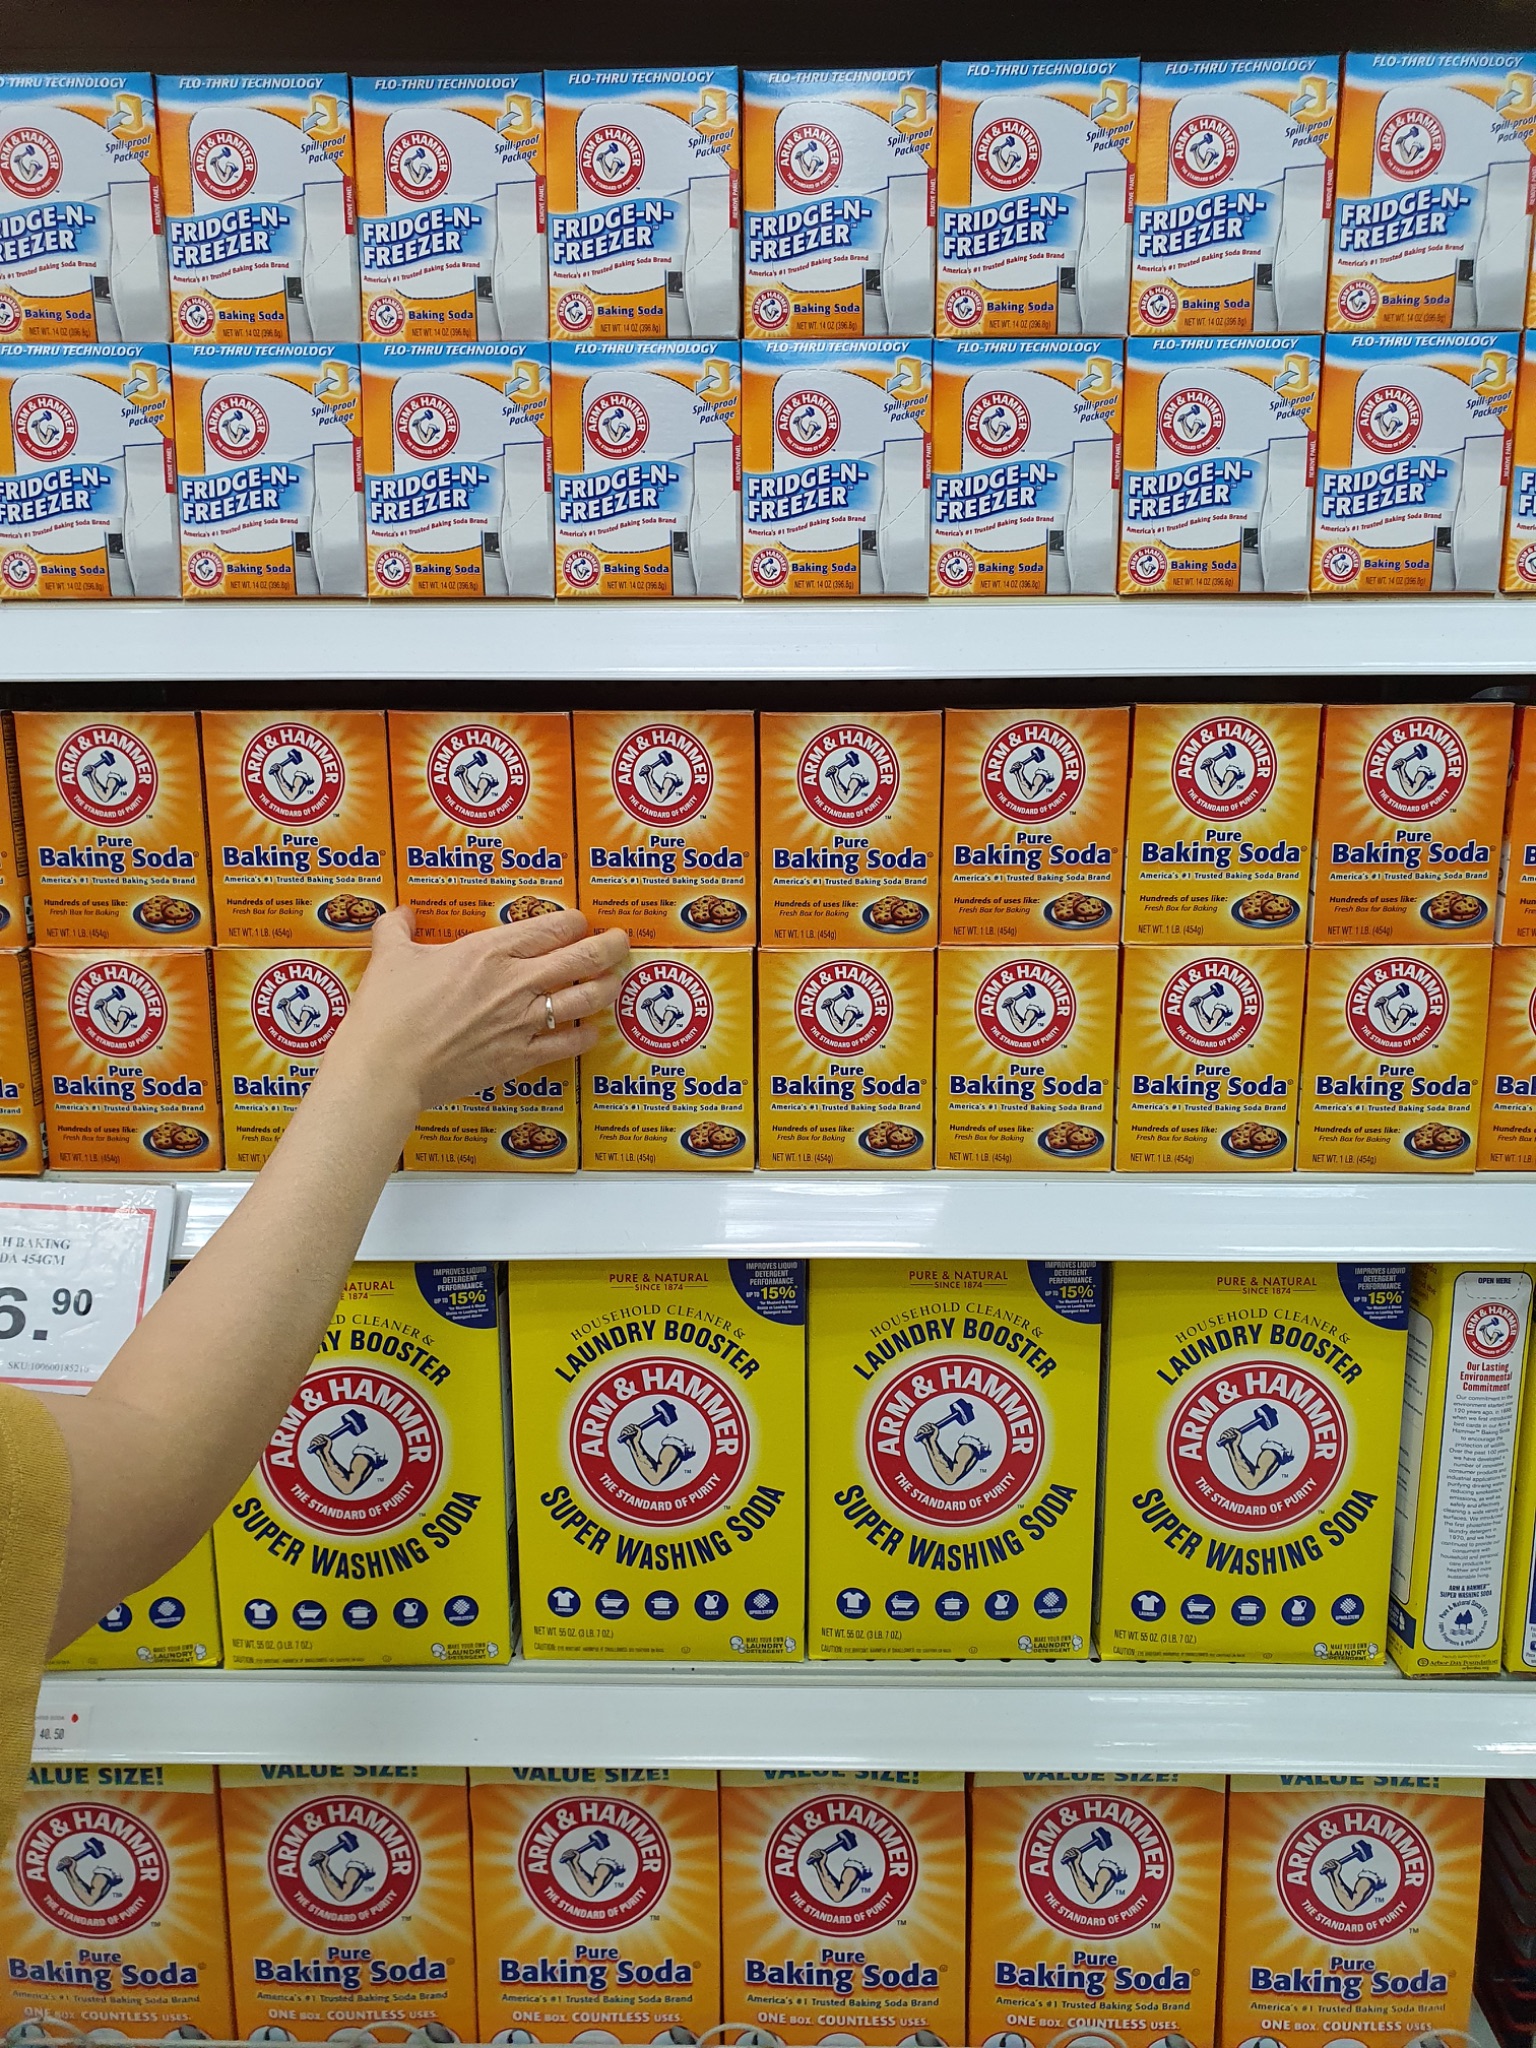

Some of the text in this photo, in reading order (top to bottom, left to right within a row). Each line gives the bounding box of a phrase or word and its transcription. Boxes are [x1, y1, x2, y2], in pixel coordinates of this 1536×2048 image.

[568, 71, 714, 85] FLO-THRU TECHNOLOGY
[688, 128, 734, 148] Spill-proof
[583, 129, 640, 168] ARM & HAMMER
[695, 143, 731, 158] Package
[1341, 186, 1471, 228] FRIDGE-N-
[170, 206, 289, 244] FRIDGE-N-
[552, 201, 674, 240] FRIDGE-N-
[1338, 212, 1447, 251] FREEZER
[553, 226, 654, 264] FREEZER
[553, 271, 581, 279] America's
[592, 265, 613, 276] Trusted
[614, 260, 635, 269] Baking
[597, 306, 663, 317] Baking Soda
[601, 324, 611, 332] NET
[624, 324, 630, 332] 14
[1351, 335, 1498, 347] FLO-THRU TECHNOLOGY
[1323, 459, 1448, 494] FRIDGE-N-
[1322, 483, 1425, 517] FREEZER
[1364, 559, 1430, 570] Baking Soda
[804, 730, 894, 786] ARM & HAMMER
[813, 795, 884, 819] THE STANDARD OF PURITY
[97, 835, 133, 847] Pure
[834, 836, 869, 848] Pure
[1396, 830, 1432, 843] Pure
[39, 846, 194, 873] Baking Soda
[773, 847, 927, 874] Baking Soda
[1332, 841, 1489, 869] Baking Soda
[855, 878, 881, 886] Baking
[905, 877, 927, 885] Brand
[825, 910, 849, 918] Baking
[774, 929, 787, 938] NET
[788, 929, 798, 938] WT.
[806, 930, 815, 938] LB.
[817, 929, 837, 940] (454g)
[1352, 964, 1442, 1016] ARM & HAMMER
[1379, 1064, 1415, 1076] Pure
[1316, 1075, 1471, 1101] Baking Soda
[16, 1238, 71, 1249] BAKING
[22, 1254, 65, 1265] 454GM
[609, 1272, 708, 1283] PURE & NATURAL
[750, 1278, 794, 1286] PERFORMANCE
[754, 1270, 788, 1278] DETERGENT
[635, 1283, 660, 1291] SINCE
[52, 1288, 93, 1316] 90
[570, 1304, 661, 1341] HOUSEHOLD
[666, 1304, 734, 1332] CLEANER
[734, 1327, 746, 1339] &
[555, 1320, 760, 1383] LAUNDRY BOOSTER
[1460, 1371, 1512, 1381] Environmental
[1467, 1362, 1509, 1372] Our Lasting
[1463, 1382, 1510, 1392] Commitment
[581, 1367, 738, 1458] ARM & HAMMER
[599, 1473, 722, 1512] THE STANDARD OF PURITY
[540, 1484, 786, 1571] SUPER WASHING SODA
[1114, 1630, 1126, 1640] NET
[1127, 1630, 1138, 1640] WT.
[1140, 1631, 1148, 1642] 55
[1160, 1632, 1168, 1643] (3
[1169, 1632, 1178, 1643] LB.
[27, 1766, 163, 1785] ALUE SIZE!
[775, 1802, 909, 1878] ARM & HAMMER
[821, 1949, 865, 1963] Pure
[746, 1959, 939, 1993] Baking Soda
[1250, 1967, 1448, 1999] Baking Soda
[747, 1994, 794, 2005] America's
[812, 1998, 846, 2006] Trusted
[849, 1999, 882, 2009] Baking
[885, 1999, 908, 2007] Soda
[911, 1998, 939, 2007] Brand
[757, 2012, 786, 2024] ONE
[817, 2015, 896, 2026] COUNTLESS
